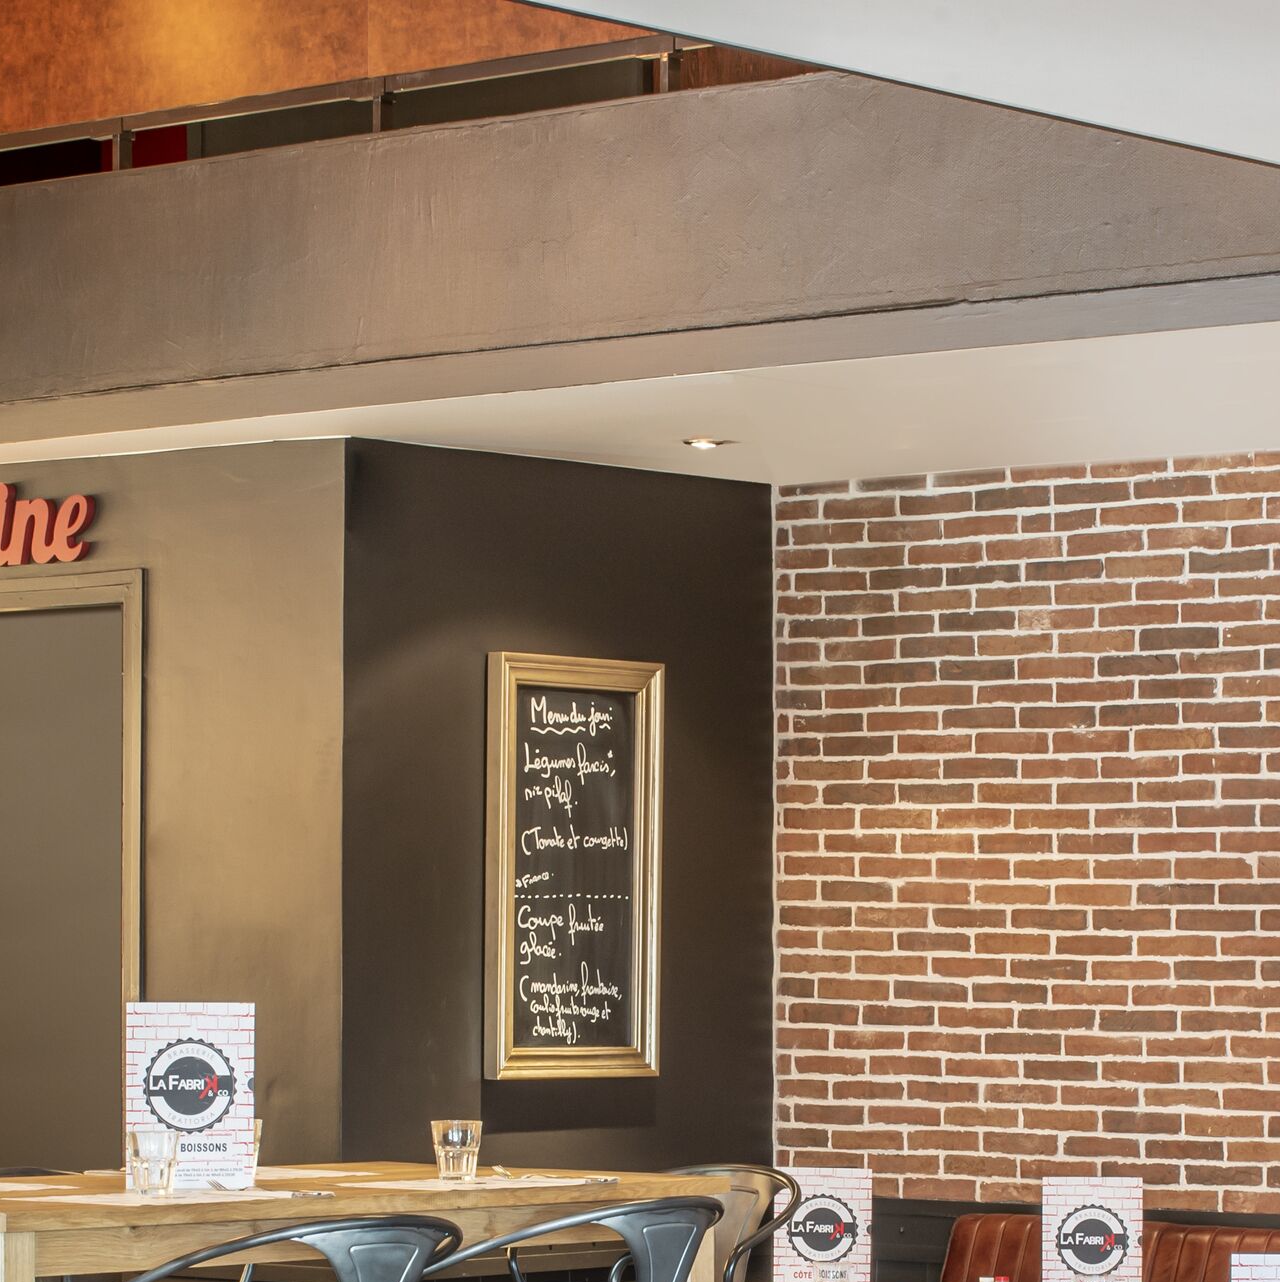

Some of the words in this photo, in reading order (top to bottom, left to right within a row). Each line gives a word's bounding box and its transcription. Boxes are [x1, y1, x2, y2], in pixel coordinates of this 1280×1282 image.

[531, 695, 570, 725] Menu
[570, 701, 587, 723] du
[566, 824, 581, 850] et
[517, 905, 564, 941] Coupe
[601, 1001, 612, 1020] et
[167, 1048, 215, 1060] BRASSERIE
[149, 1074, 165, 1091] LA
[168, 1074, 218, 1099] FABRIK
[180, 1142, 228, 1153] BOISSONS
[791, 1221, 805, 1233] LA
[1060, 1232, 1075, 1245] LA
